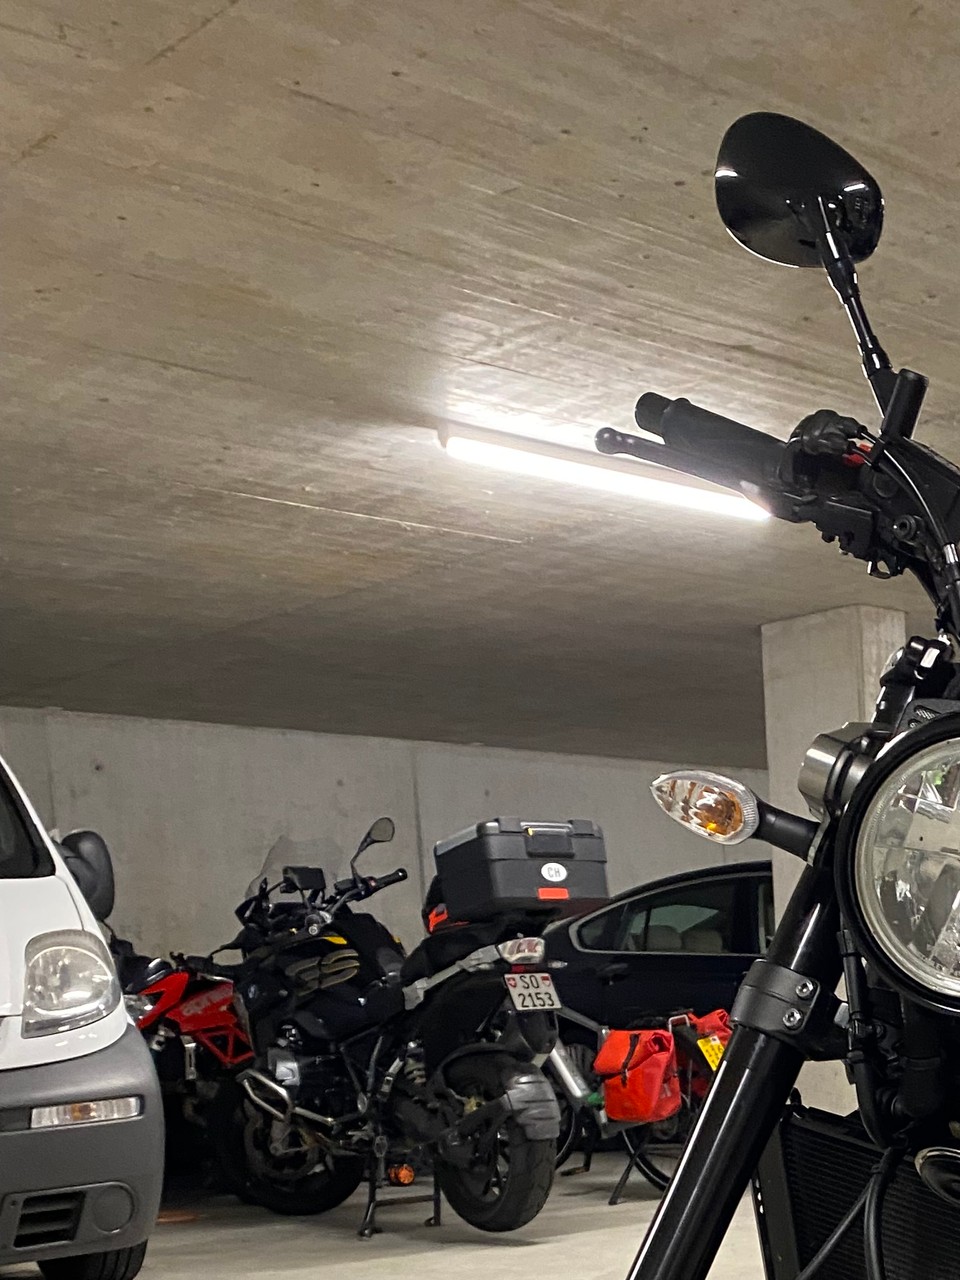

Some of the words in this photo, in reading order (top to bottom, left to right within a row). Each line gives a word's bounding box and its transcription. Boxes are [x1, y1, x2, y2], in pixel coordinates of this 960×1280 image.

[547, 866, 561, 878] CH
[285, 949, 360, 997] GS
[519, 975, 540, 989] SO
[518, 992, 555, 1008] 2153
